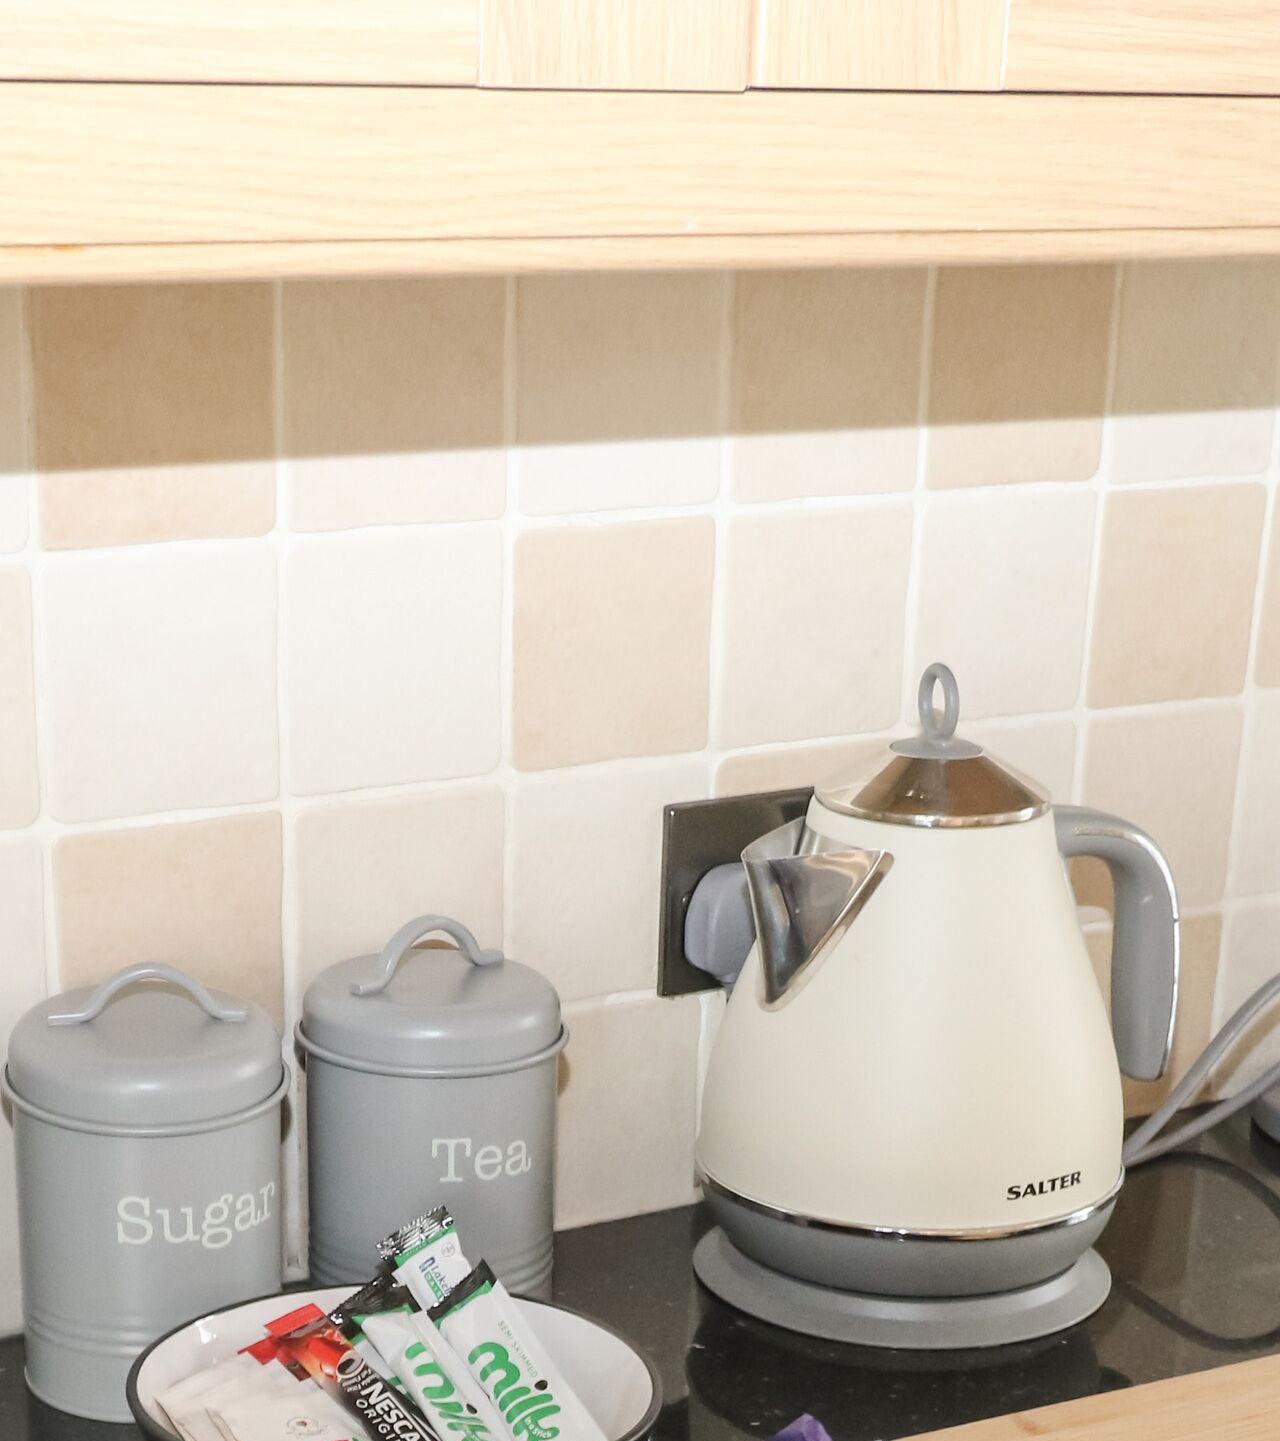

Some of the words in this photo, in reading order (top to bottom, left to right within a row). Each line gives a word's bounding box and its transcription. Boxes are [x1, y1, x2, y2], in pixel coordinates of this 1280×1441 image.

[431, 1138, 532, 1183] Tea
[1006, 1171, 1081, 1201] SALTER
[117, 1181, 276, 1250] Sugar
